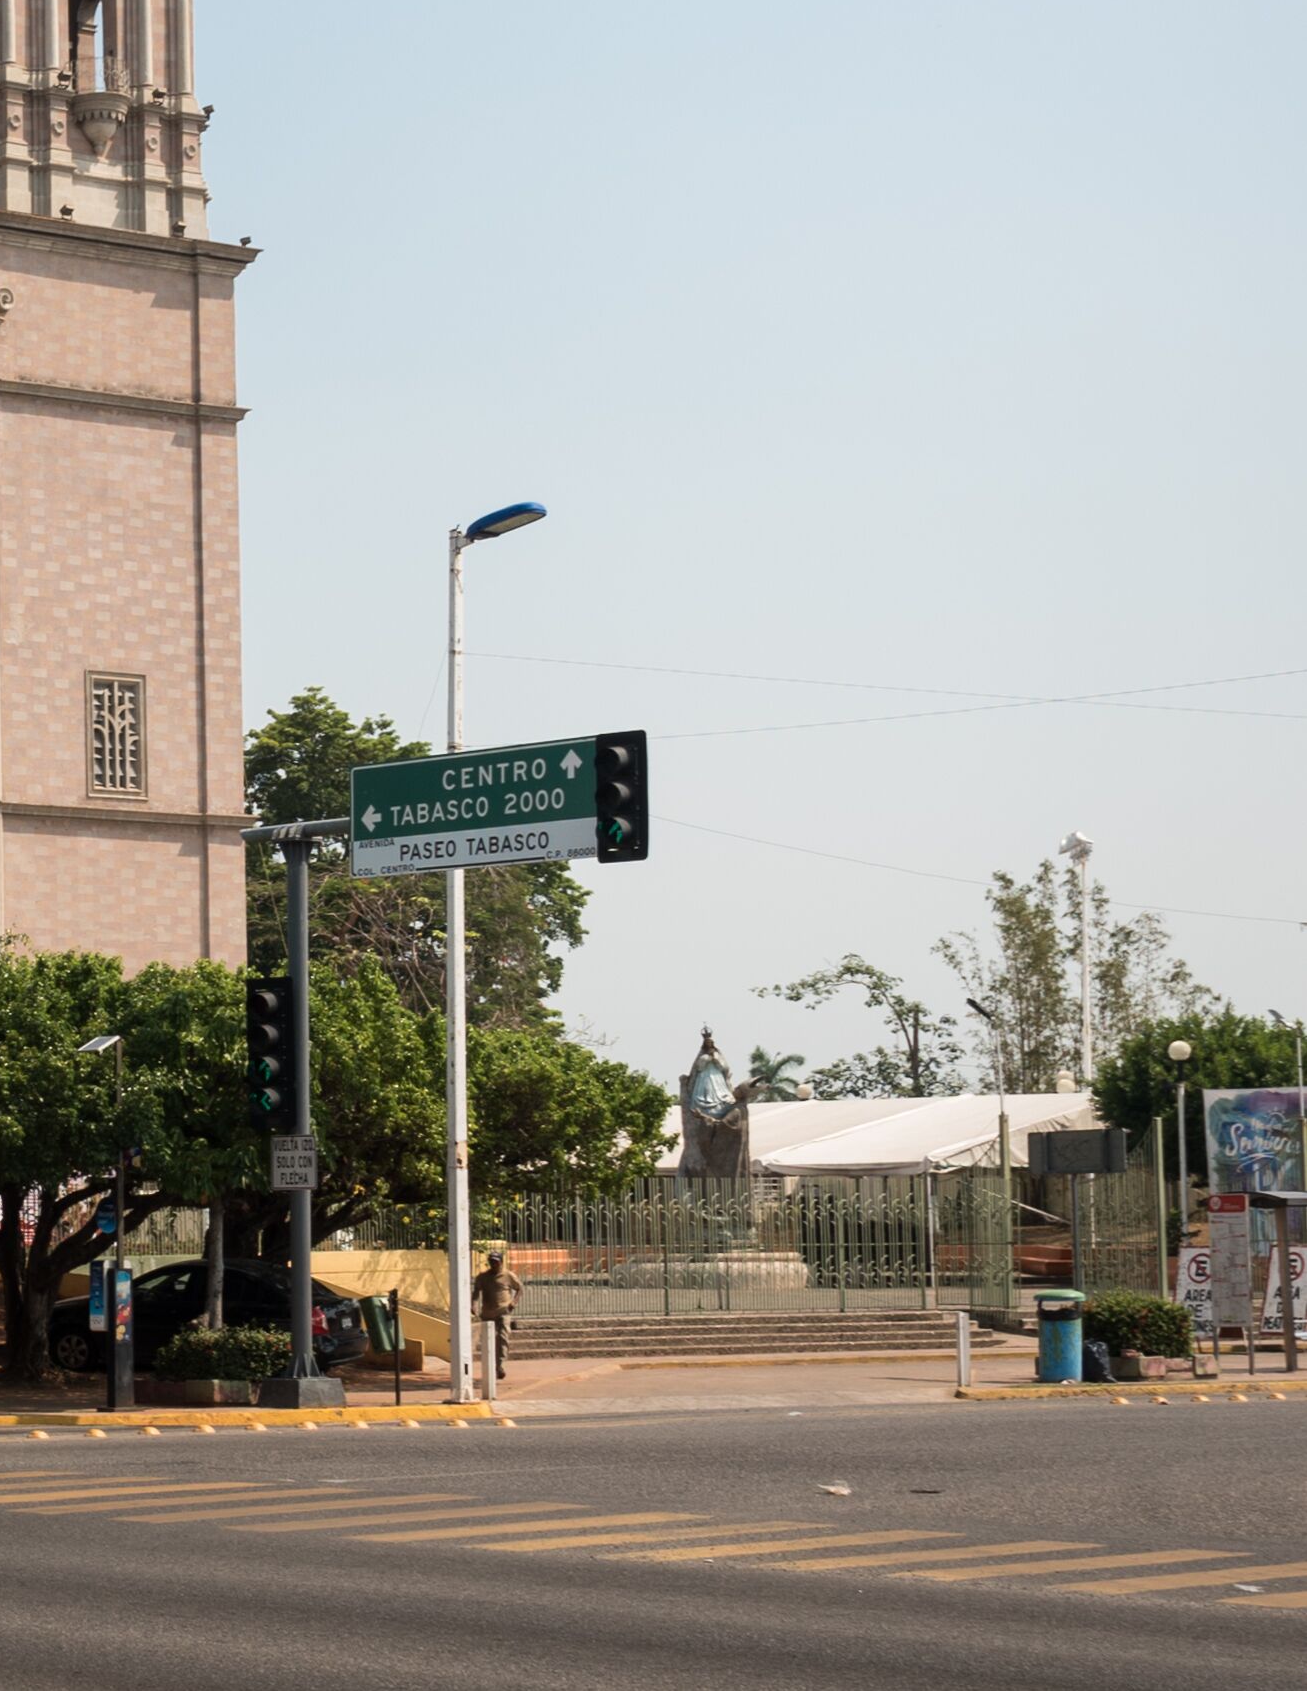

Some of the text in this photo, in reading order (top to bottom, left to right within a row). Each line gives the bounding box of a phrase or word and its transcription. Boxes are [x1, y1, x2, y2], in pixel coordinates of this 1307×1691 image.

[442, 758, 547, 790] CENTRO
[390, 788, 565, 826] TABASCO 2000
[358, 839, 395, 849] AVENIDA
[399, 831, 550, 861] PASEO TABASCO
[381, 863, 415, 874] CENTRO
[277, 1155, 312, 1169] SOLO CON
[280, 1172, 309, 1185] FLECHA
